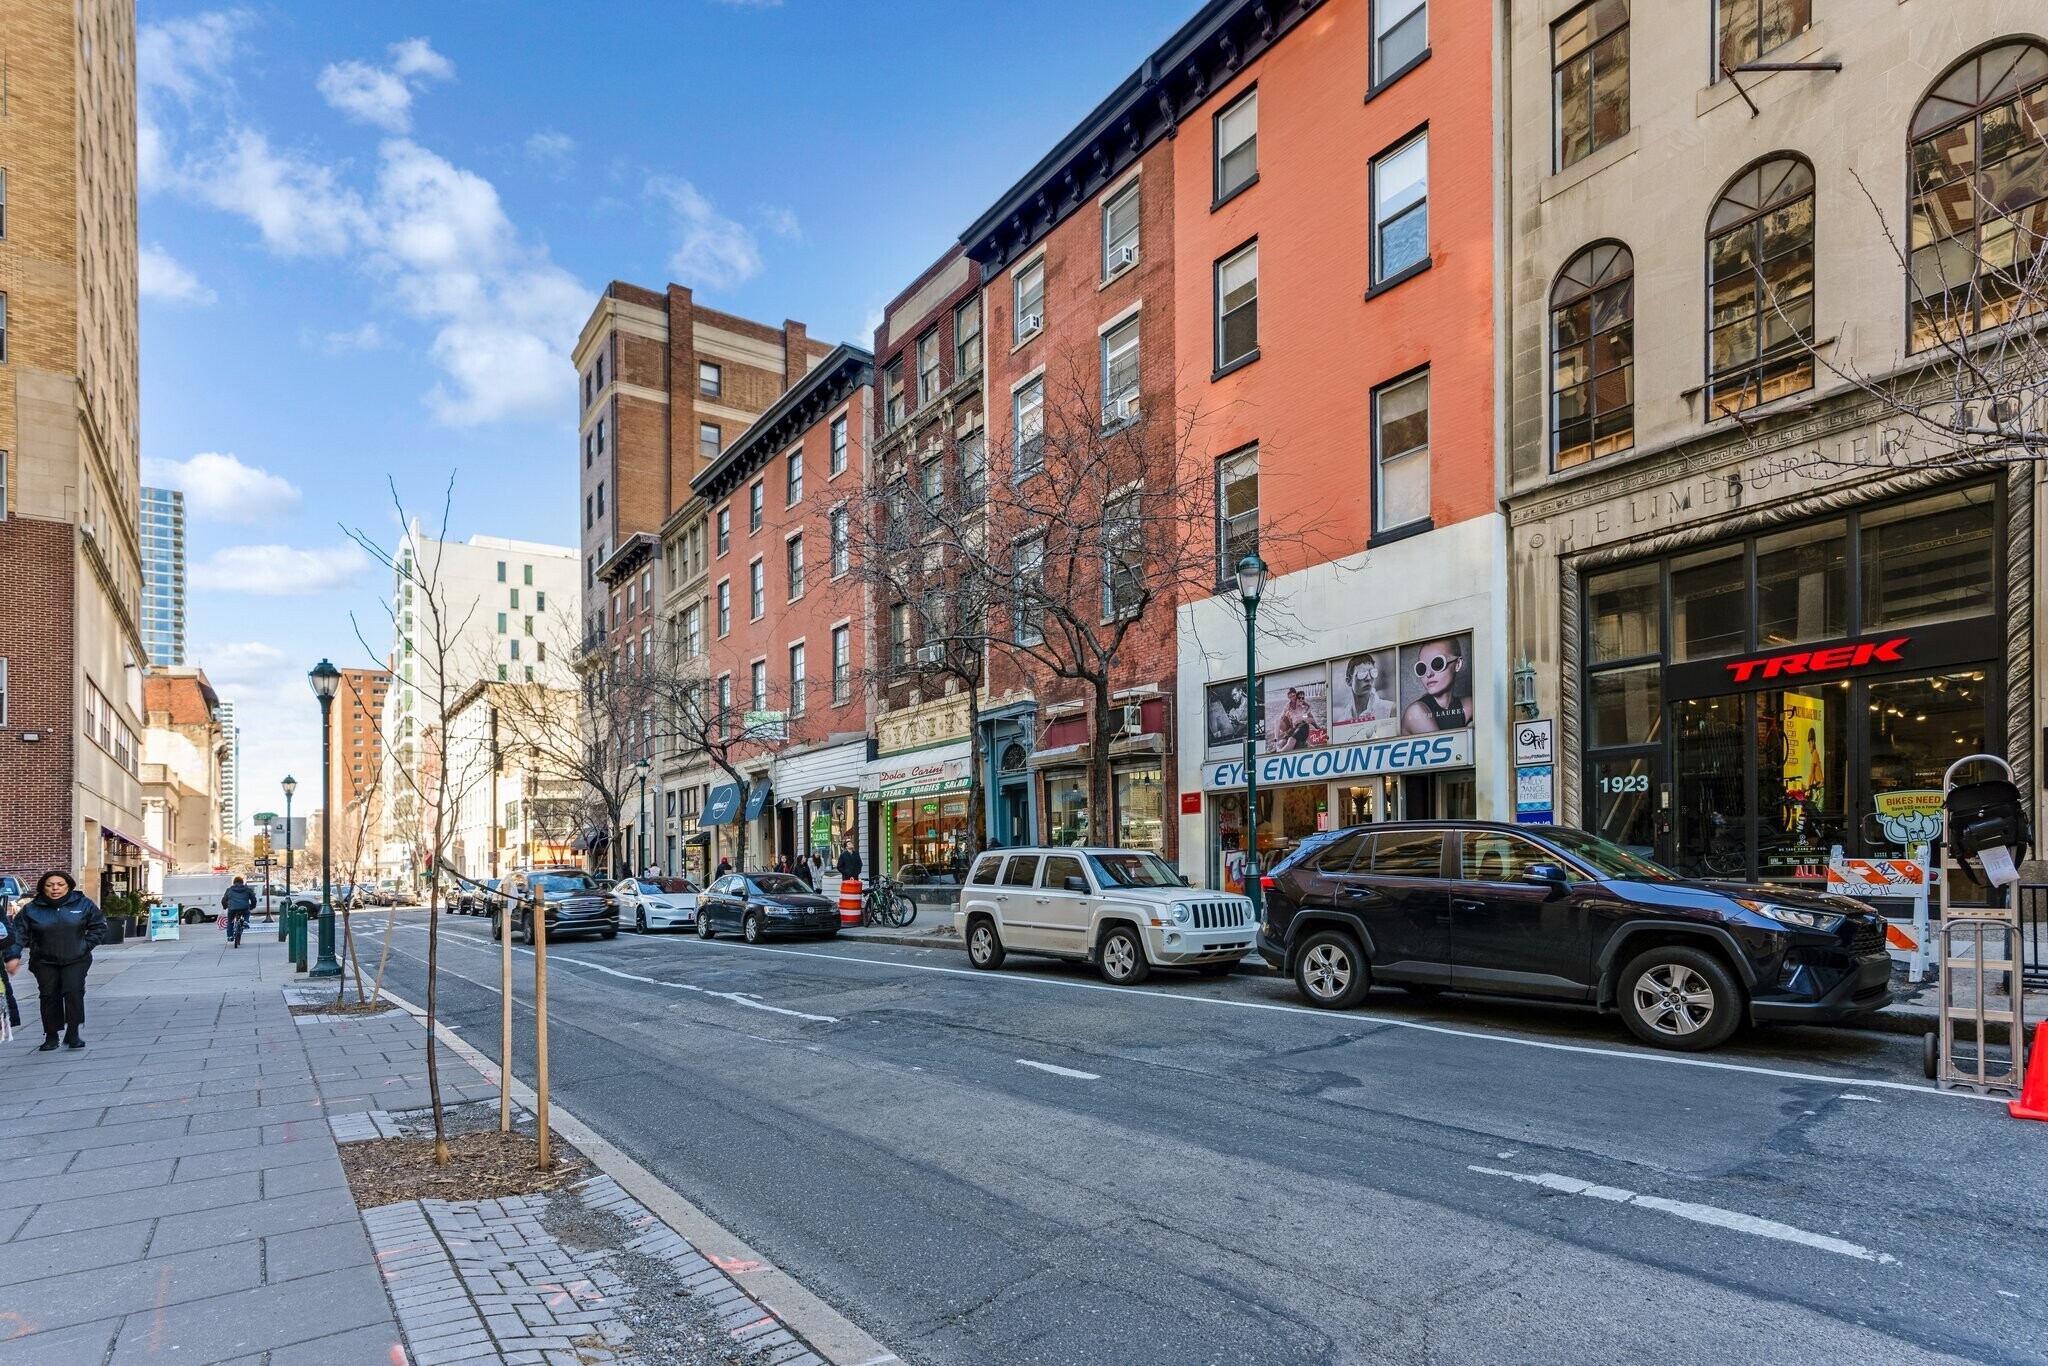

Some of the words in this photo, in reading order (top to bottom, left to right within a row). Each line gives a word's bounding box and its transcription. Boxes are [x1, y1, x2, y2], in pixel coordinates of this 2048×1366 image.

[1631, 427, 1903, 523] LIMEBURNER
[1726, 637, 1911, 683] TREK
[1350, 716, 1375, 725] PRADA
[1264, 736, 1454, 781] ENCOUNTERS
[881, 770, 907, 781] Dolce
[911, 763, 945, 777] Carini
[862, 791, 879, 800] PIZZA
[881, 788, 907, 799] STEAKS
[910, 783, 941, 795] HOAGIES
[943, 779, 969, 790] SALAD
[1600, 774, 1649, 794] 1923
[1519, 792, 1550, 801] FITNESS
[1886, 796, 1914, 806] BIKES
[1915, 795, 1941, 804] NEED
[814, 833, 829, 841] LEASE
[1793, 864, 1823, 879] ALL
